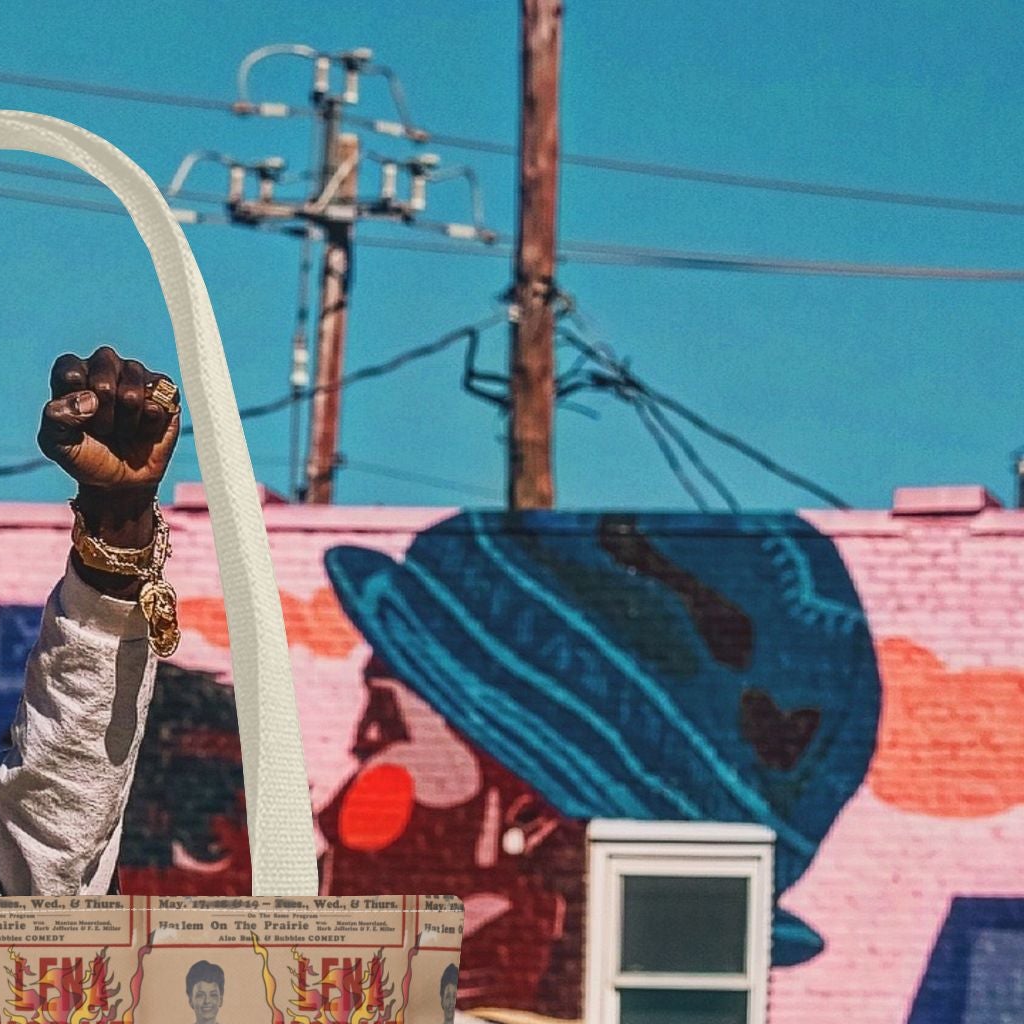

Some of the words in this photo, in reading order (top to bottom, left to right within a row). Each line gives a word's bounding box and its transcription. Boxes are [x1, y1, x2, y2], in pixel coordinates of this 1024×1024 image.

[70, 899, 80, 909] &
[85, 899, 125, 909] Thurs.
[25, 934, 65, 942] COMEDY
